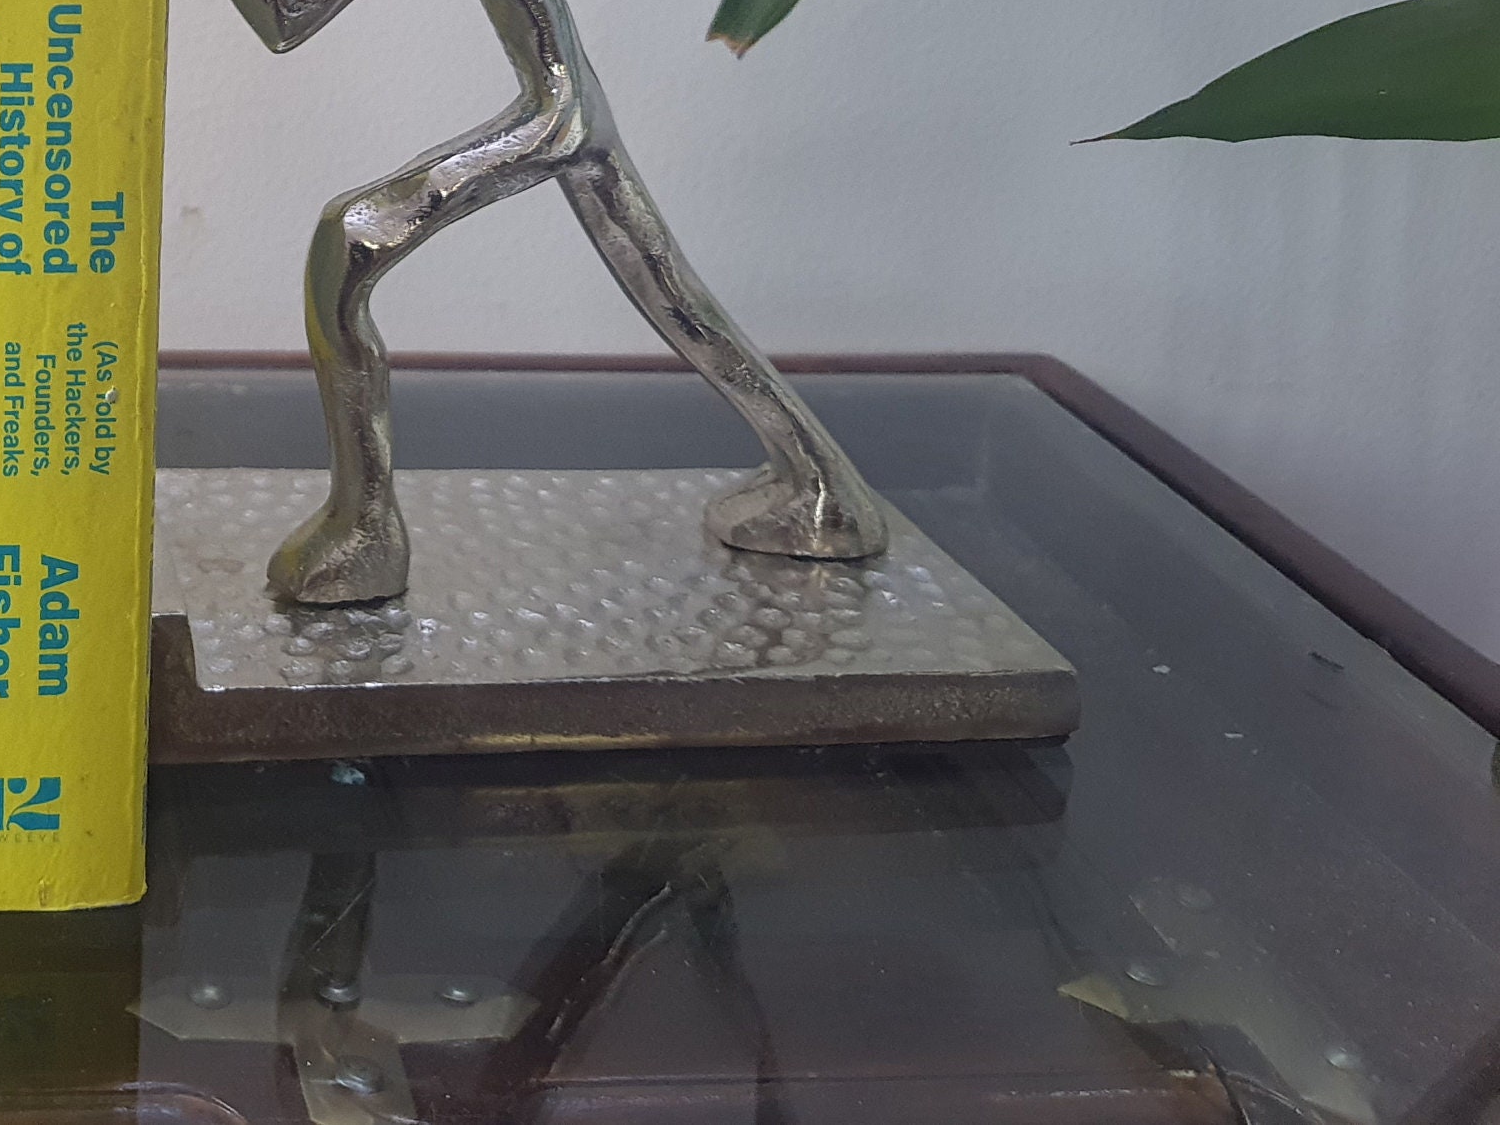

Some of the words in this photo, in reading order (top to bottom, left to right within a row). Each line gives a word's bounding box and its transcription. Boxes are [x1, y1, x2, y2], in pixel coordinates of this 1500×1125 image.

[44, 5, 82, 273] Uncensored
[90, 193, 125, 273] The
[4, 341, 25, 388] and
[66, 322, 88, 362] the
[93, 341, 119, 382] (As
[3, 395, 25, 477] Freaks
[30, 354, 57, 476] Founders,
[61, 370, 86, 476] Hackers,
[89, 446, 116, 475] by
[39, 556, 80, 696] Adam
